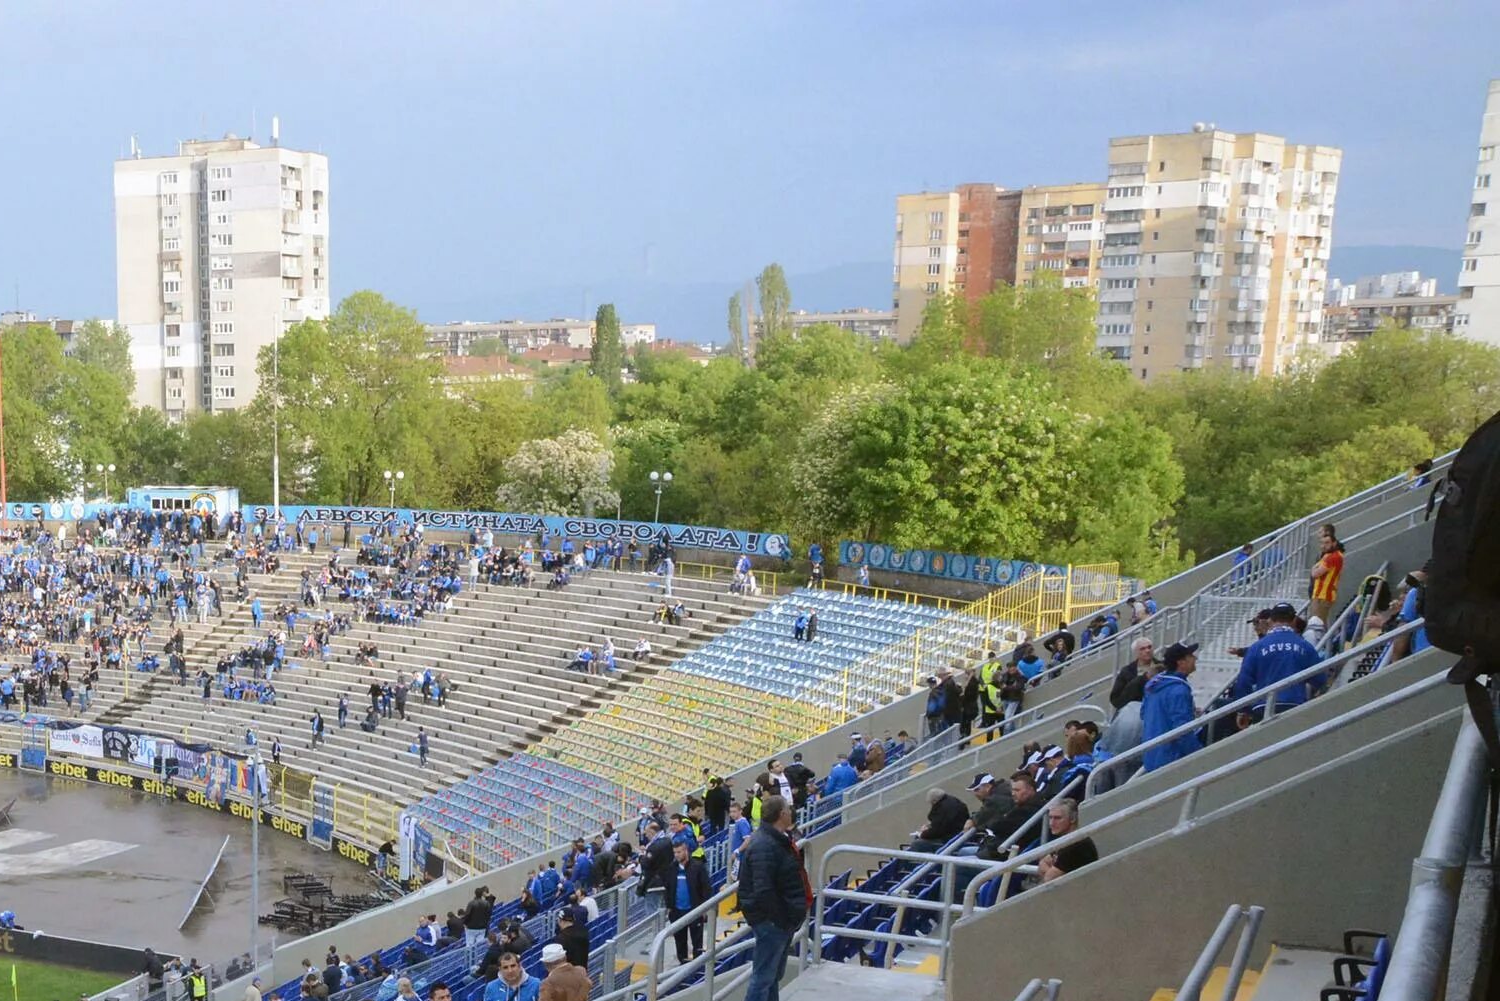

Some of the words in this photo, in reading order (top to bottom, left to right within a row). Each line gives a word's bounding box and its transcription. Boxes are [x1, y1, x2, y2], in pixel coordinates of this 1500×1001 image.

[50, 762, 88, 779] efbet
[98, 770, 134, 788] efbet
[230, 802, 263, 824] efbt
[271, 815, 303, 838] efbet
[338, 840, 369, 866] efbet
